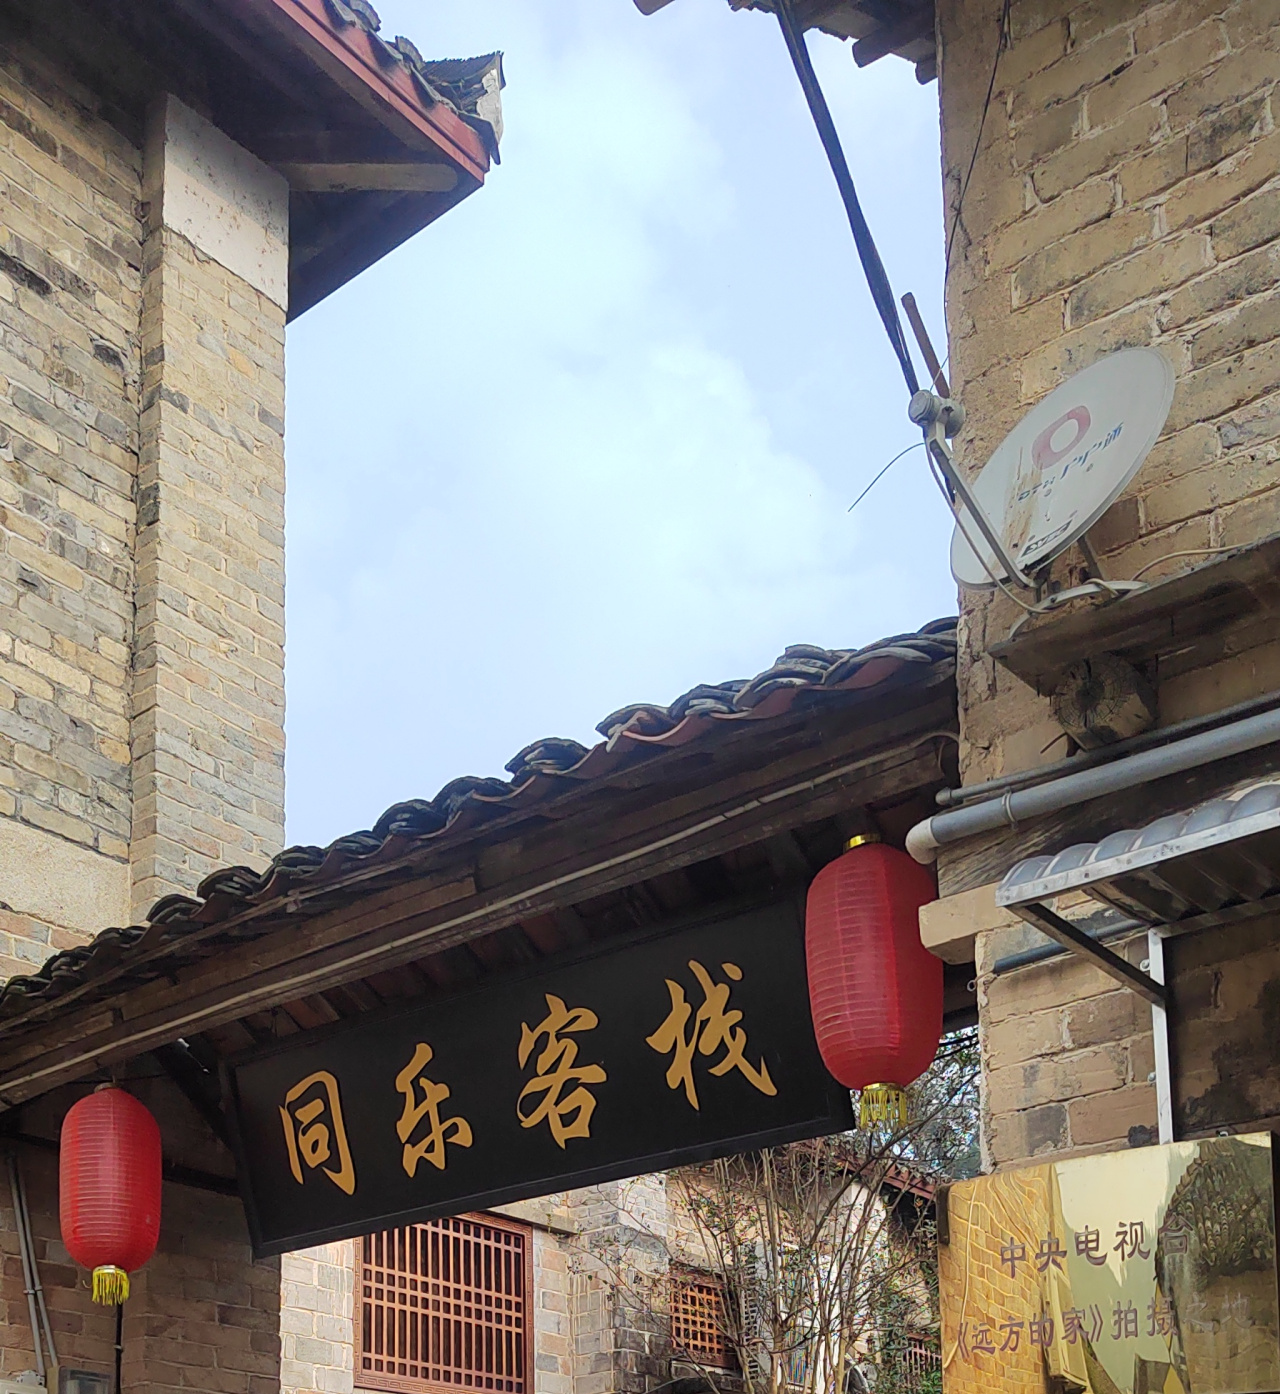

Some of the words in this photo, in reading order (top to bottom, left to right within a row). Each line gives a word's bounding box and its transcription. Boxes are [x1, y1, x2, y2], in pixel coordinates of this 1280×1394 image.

[278, 959, 778, 1196] 同乐客栈
[1000, 1213, 1194, 1279] 中央电视台
